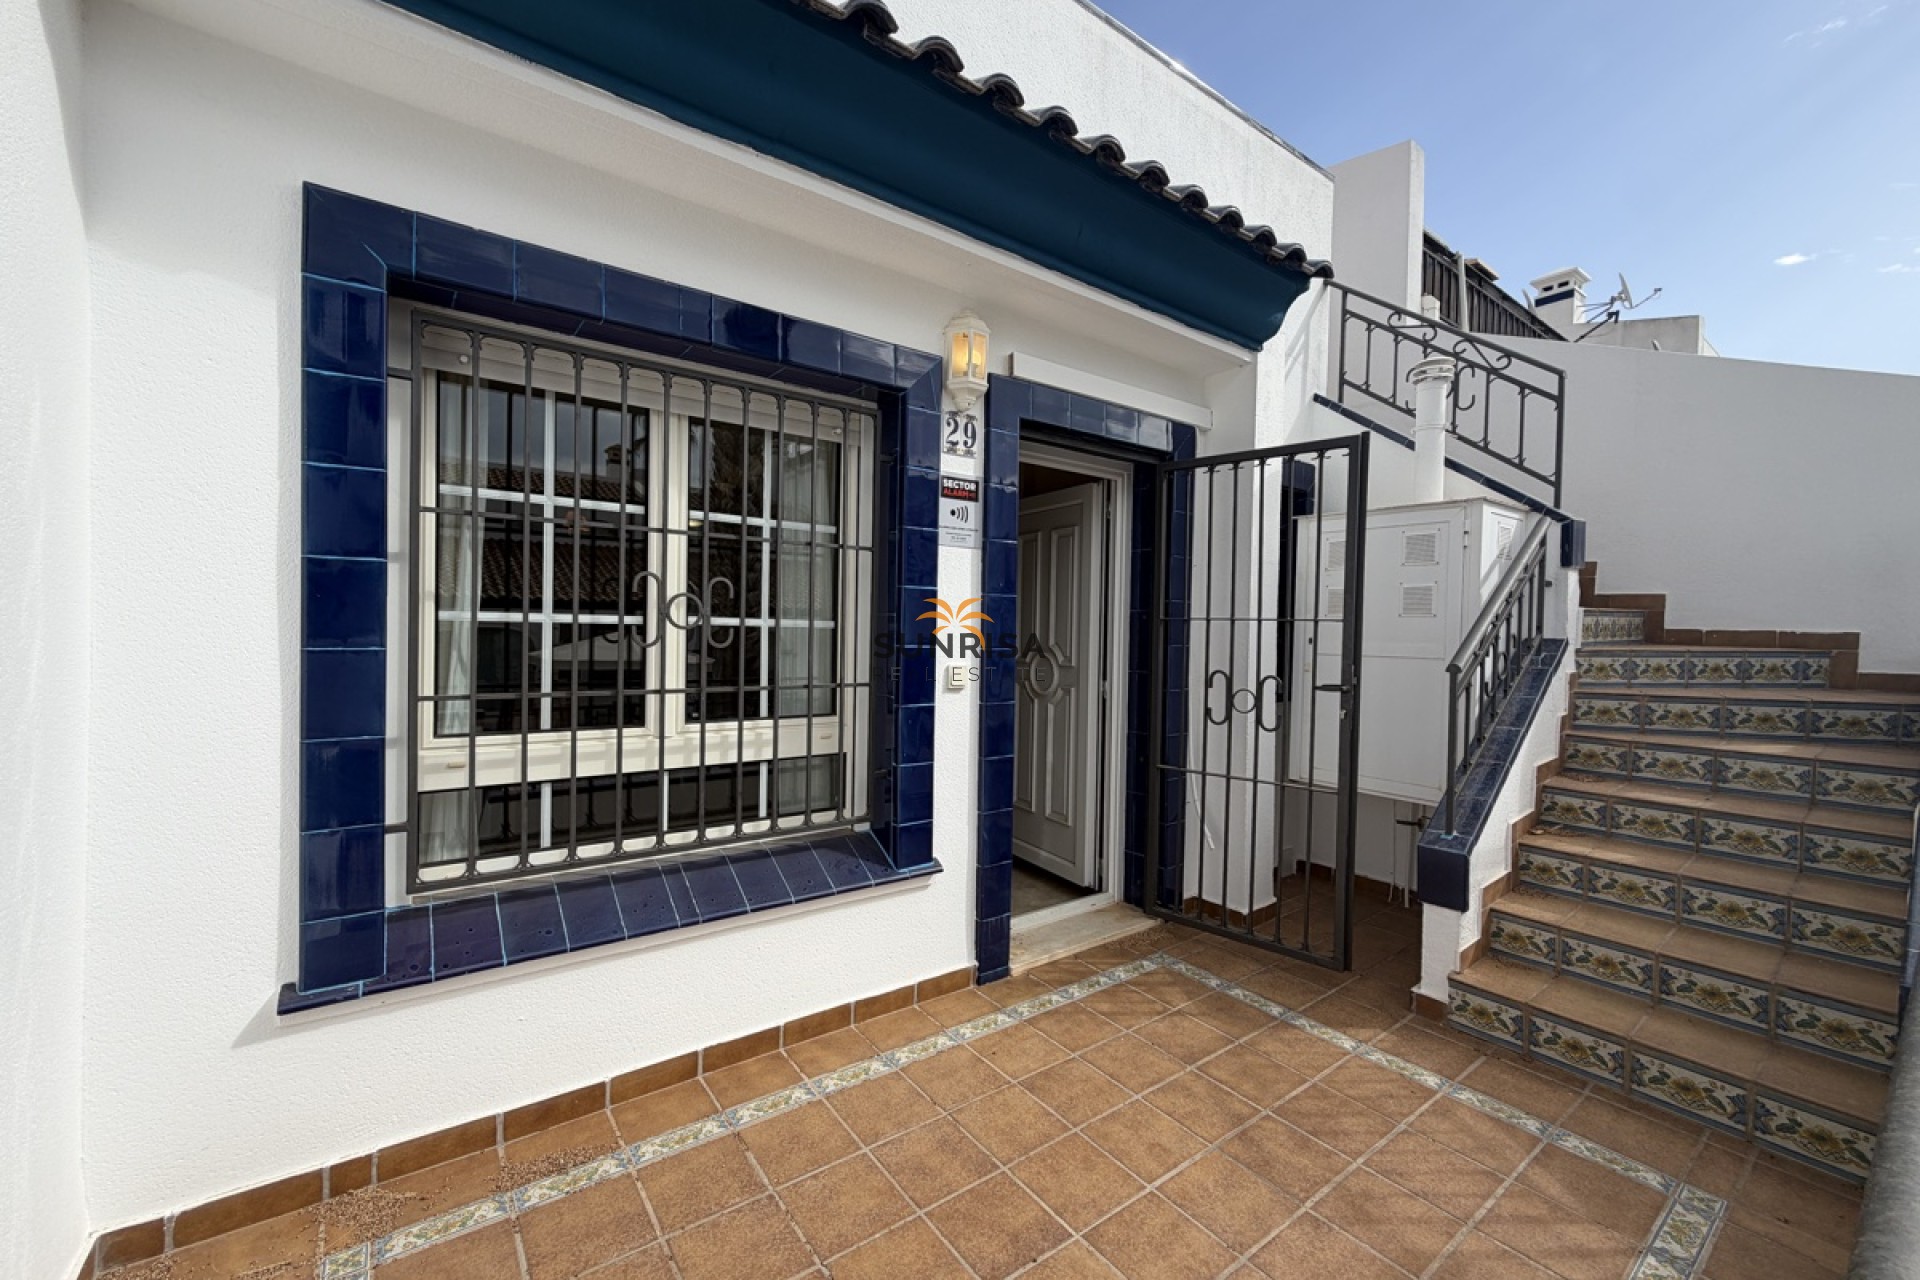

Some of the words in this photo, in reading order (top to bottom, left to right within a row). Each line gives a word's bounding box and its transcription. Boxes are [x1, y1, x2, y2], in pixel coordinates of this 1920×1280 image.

[946, 416, 977, 449] 29
[943, 478, 976, 491] SECTOR
[943, 487, 969, 498] ALARM
